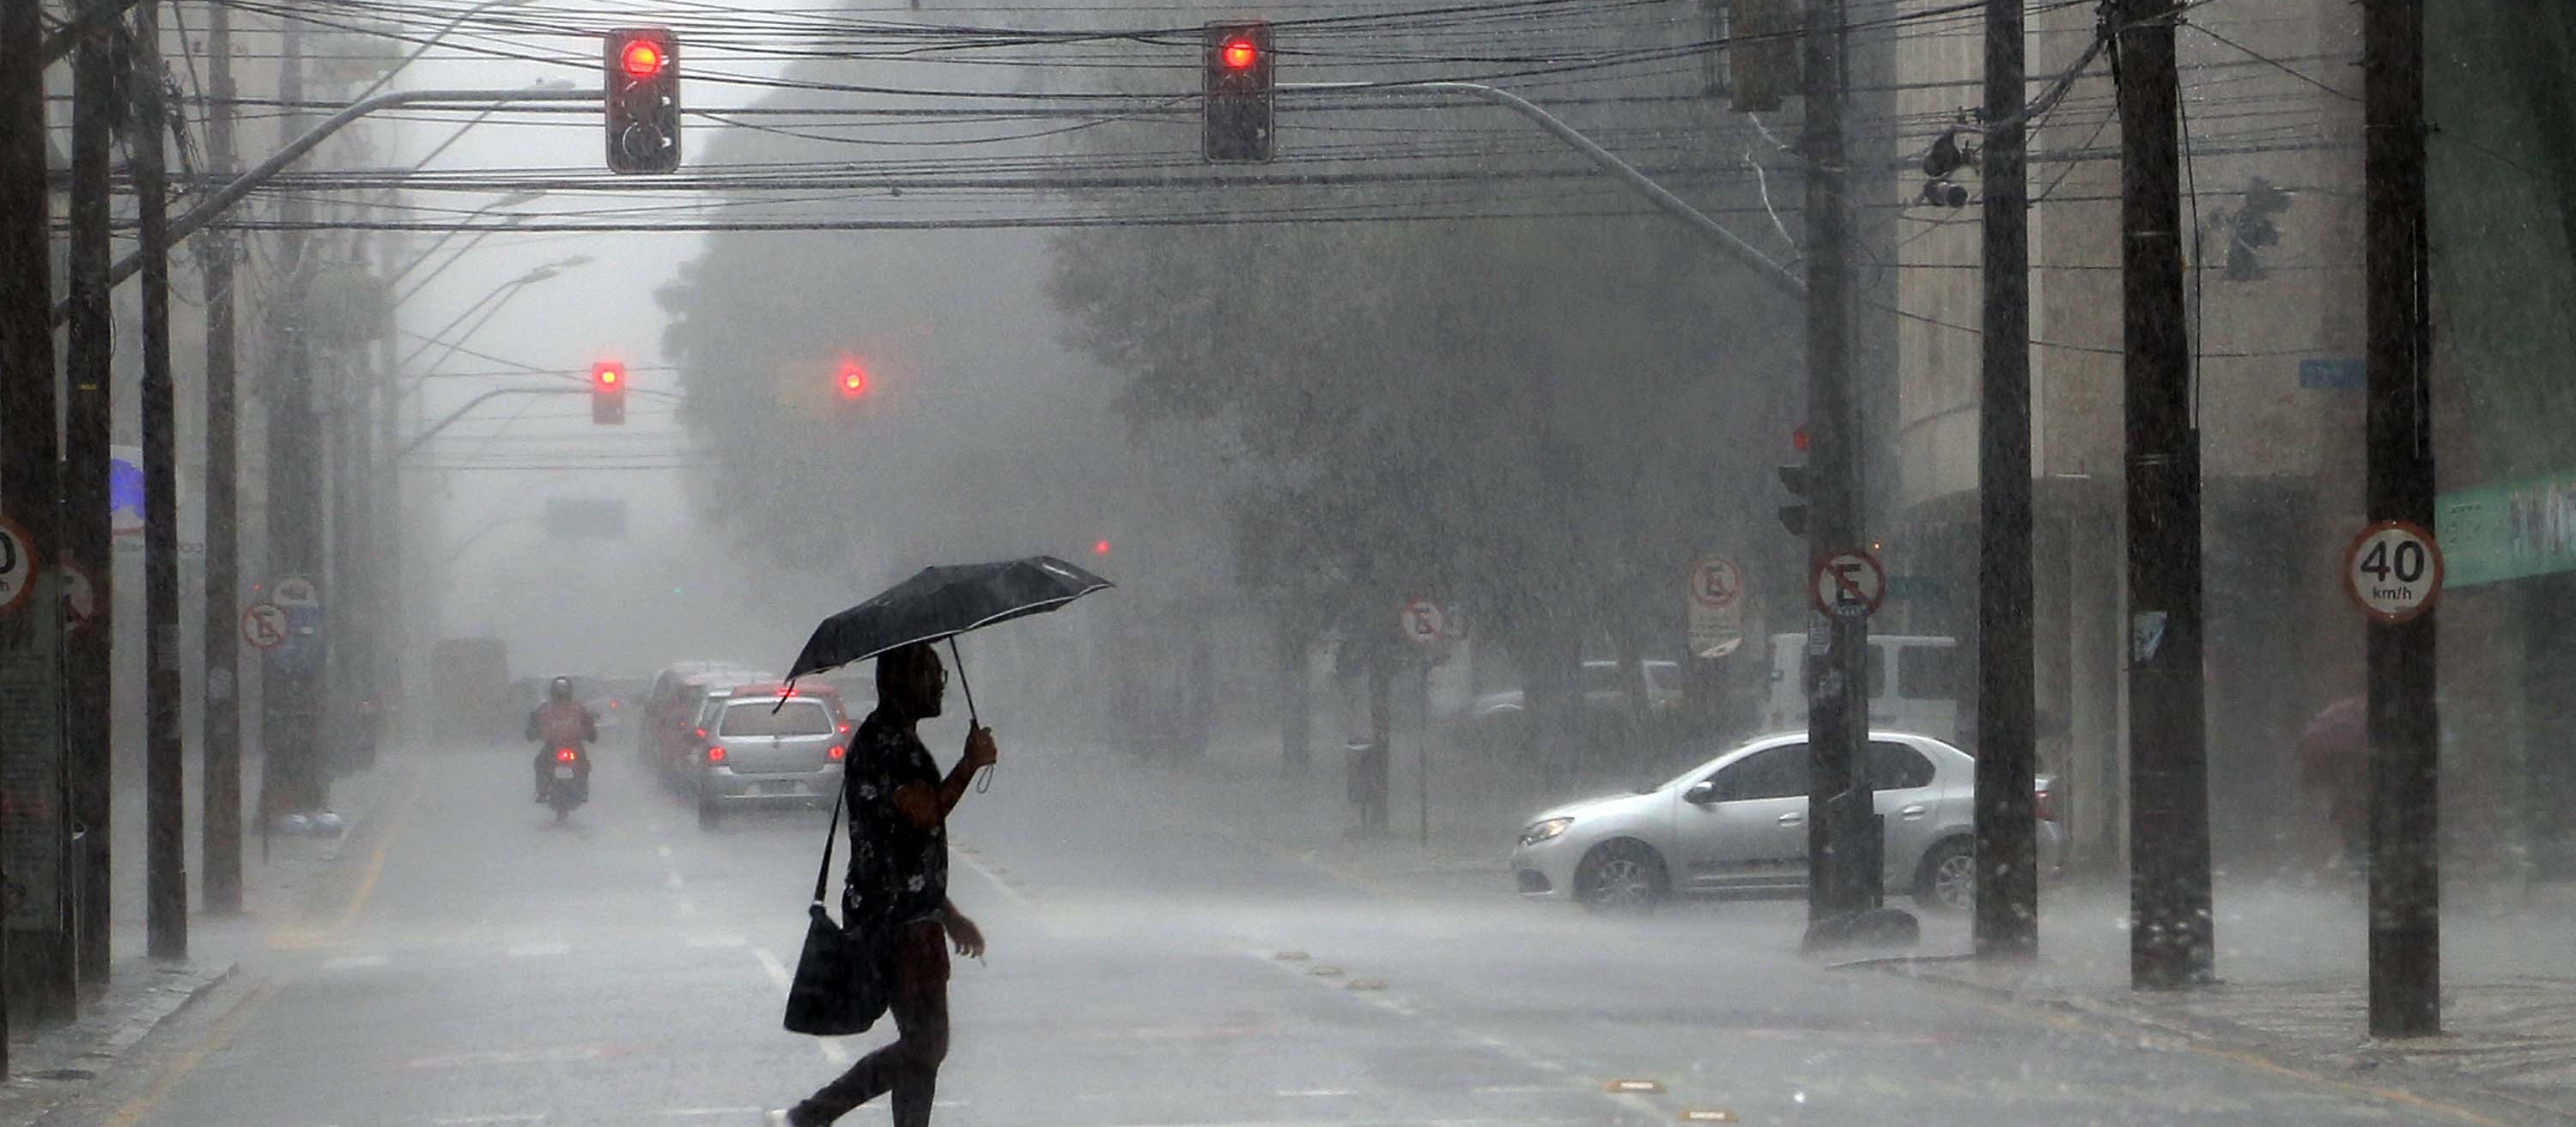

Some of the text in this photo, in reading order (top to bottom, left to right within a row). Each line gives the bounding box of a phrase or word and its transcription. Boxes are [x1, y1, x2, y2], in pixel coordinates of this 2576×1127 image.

[0, 532, 16, 574] 0
[2360, 541, 2425, 583] 40
[2372, 588, 2412, 600] km/h
